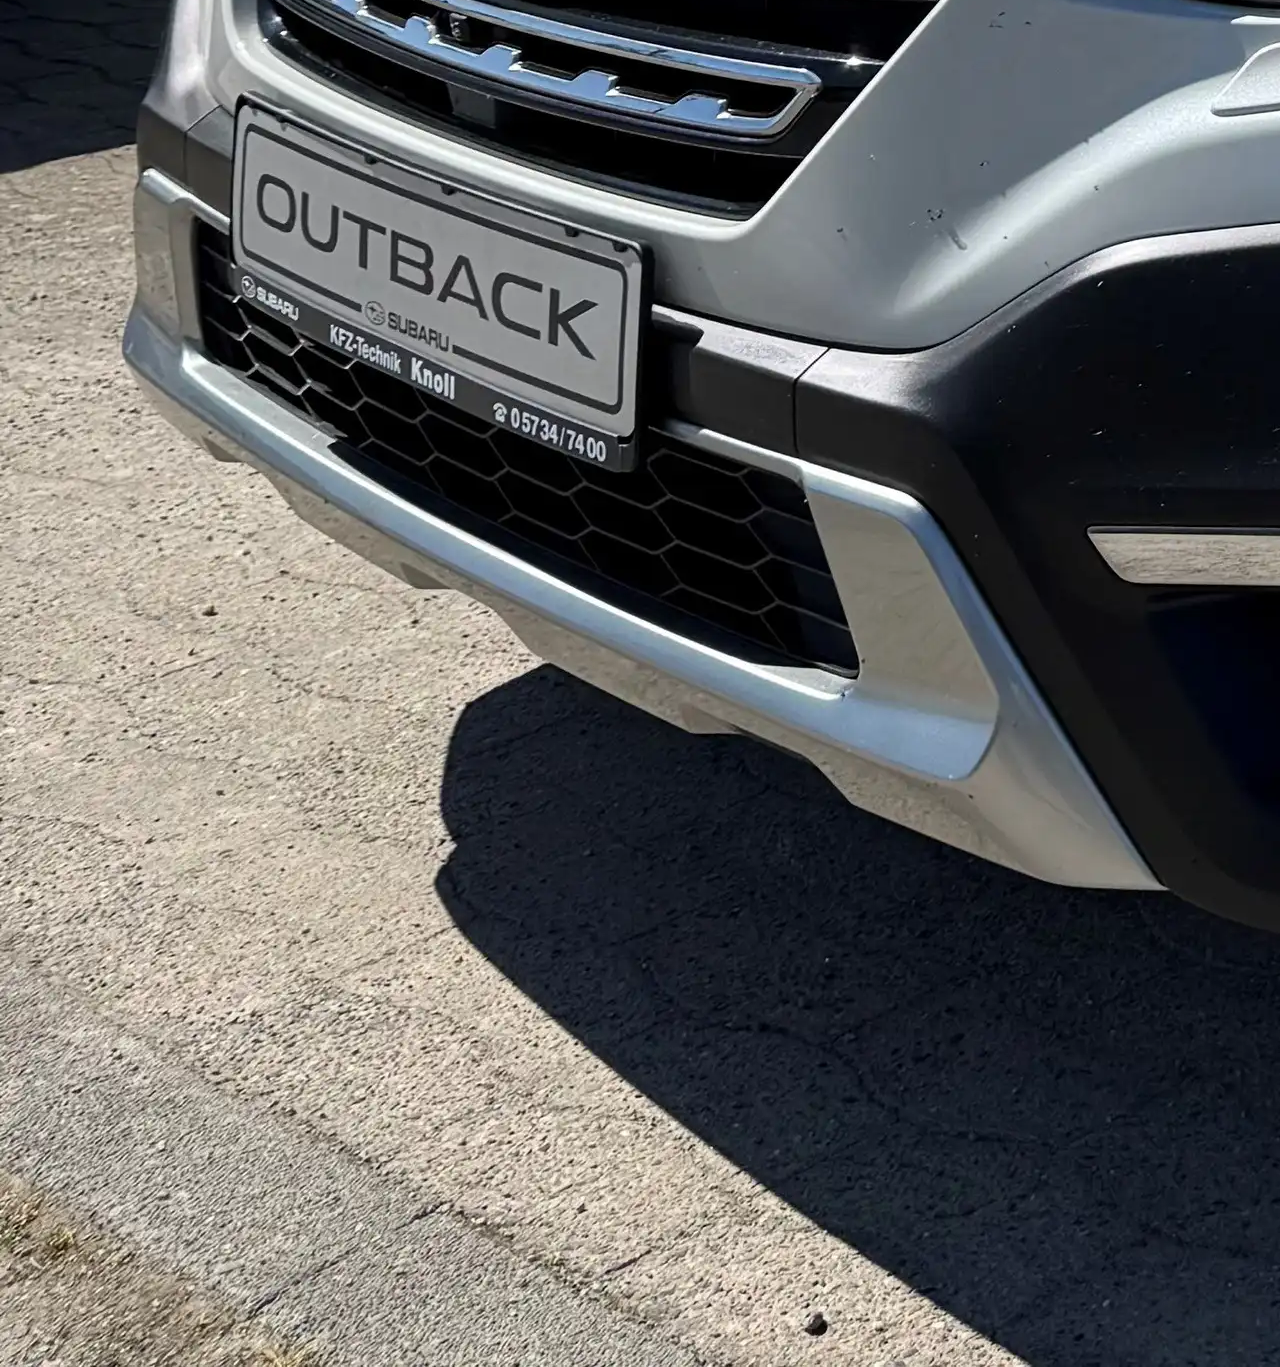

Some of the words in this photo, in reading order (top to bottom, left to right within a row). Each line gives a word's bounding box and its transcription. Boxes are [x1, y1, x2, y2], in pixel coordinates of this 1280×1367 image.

[255, 173, 599, 361] OUTBACK
[256, 286, 300, 322] SUBARU
[387, 311, 450, 352] SUBARU
[329, 323, 402, 374] KFZ-Technik
[410, 356, 456, 400] Knoll
